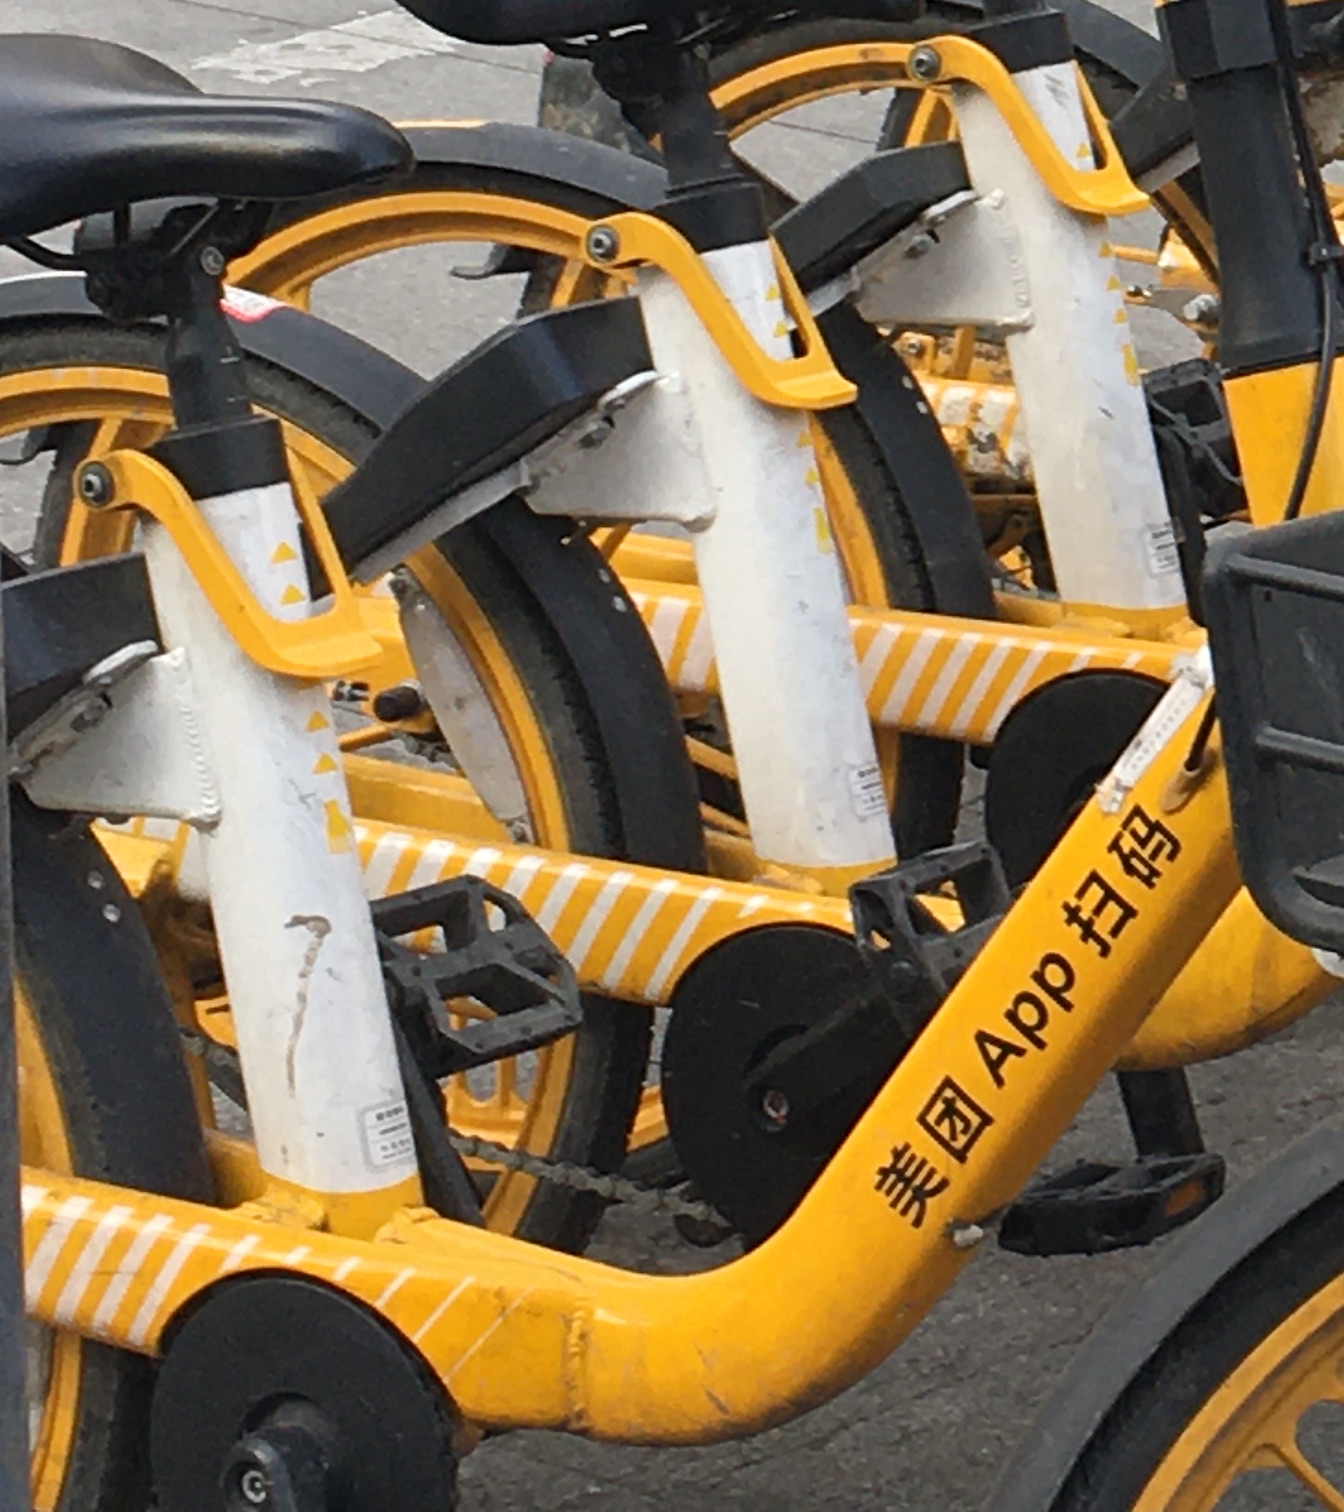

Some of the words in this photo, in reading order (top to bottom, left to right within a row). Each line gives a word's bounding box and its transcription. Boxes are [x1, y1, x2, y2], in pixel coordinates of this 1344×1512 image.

[873, 1076, 995, 1229] 美团
[973, 951, 1077, 1090] App
[1061, 804, 1182, 959] 扫码
